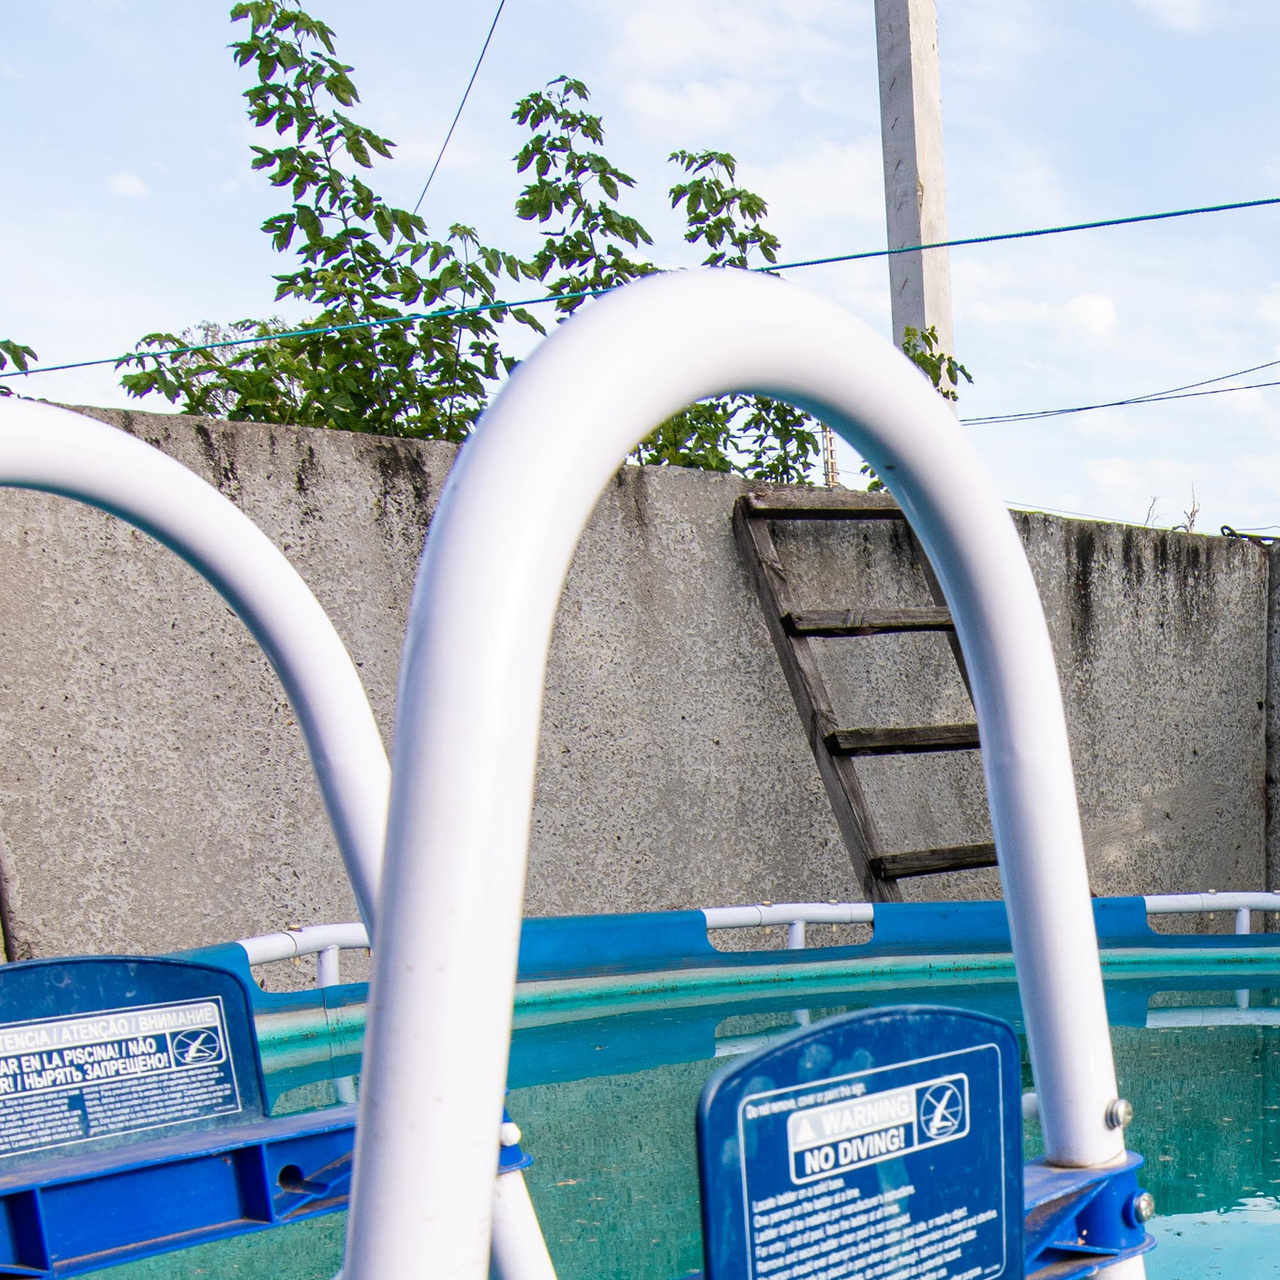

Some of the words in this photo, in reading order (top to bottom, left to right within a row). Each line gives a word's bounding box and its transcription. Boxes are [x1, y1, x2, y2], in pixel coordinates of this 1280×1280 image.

[61, 1017, 129, 1042] ATENÇÃO
[139, 1006, 214, 1033] ВНИМАНИЕ
[21, 1055, 42, 1073] EN
[43, 1052, 62, 1070] LA
[63, 1043, 120, 1067] PISCINA!
[128, 1036, 157, 1057] NÃO
[23, 1066, 83, 1090] НЫРЯТЬ
[83, 1052, 170, 1080] ЗАПРЕЩЕНО!
[821, 1095, 910, 1136] WARNING
[804, 1146, 835, 1175] NO
[838, 1126, 905, 1166] DIVING!
